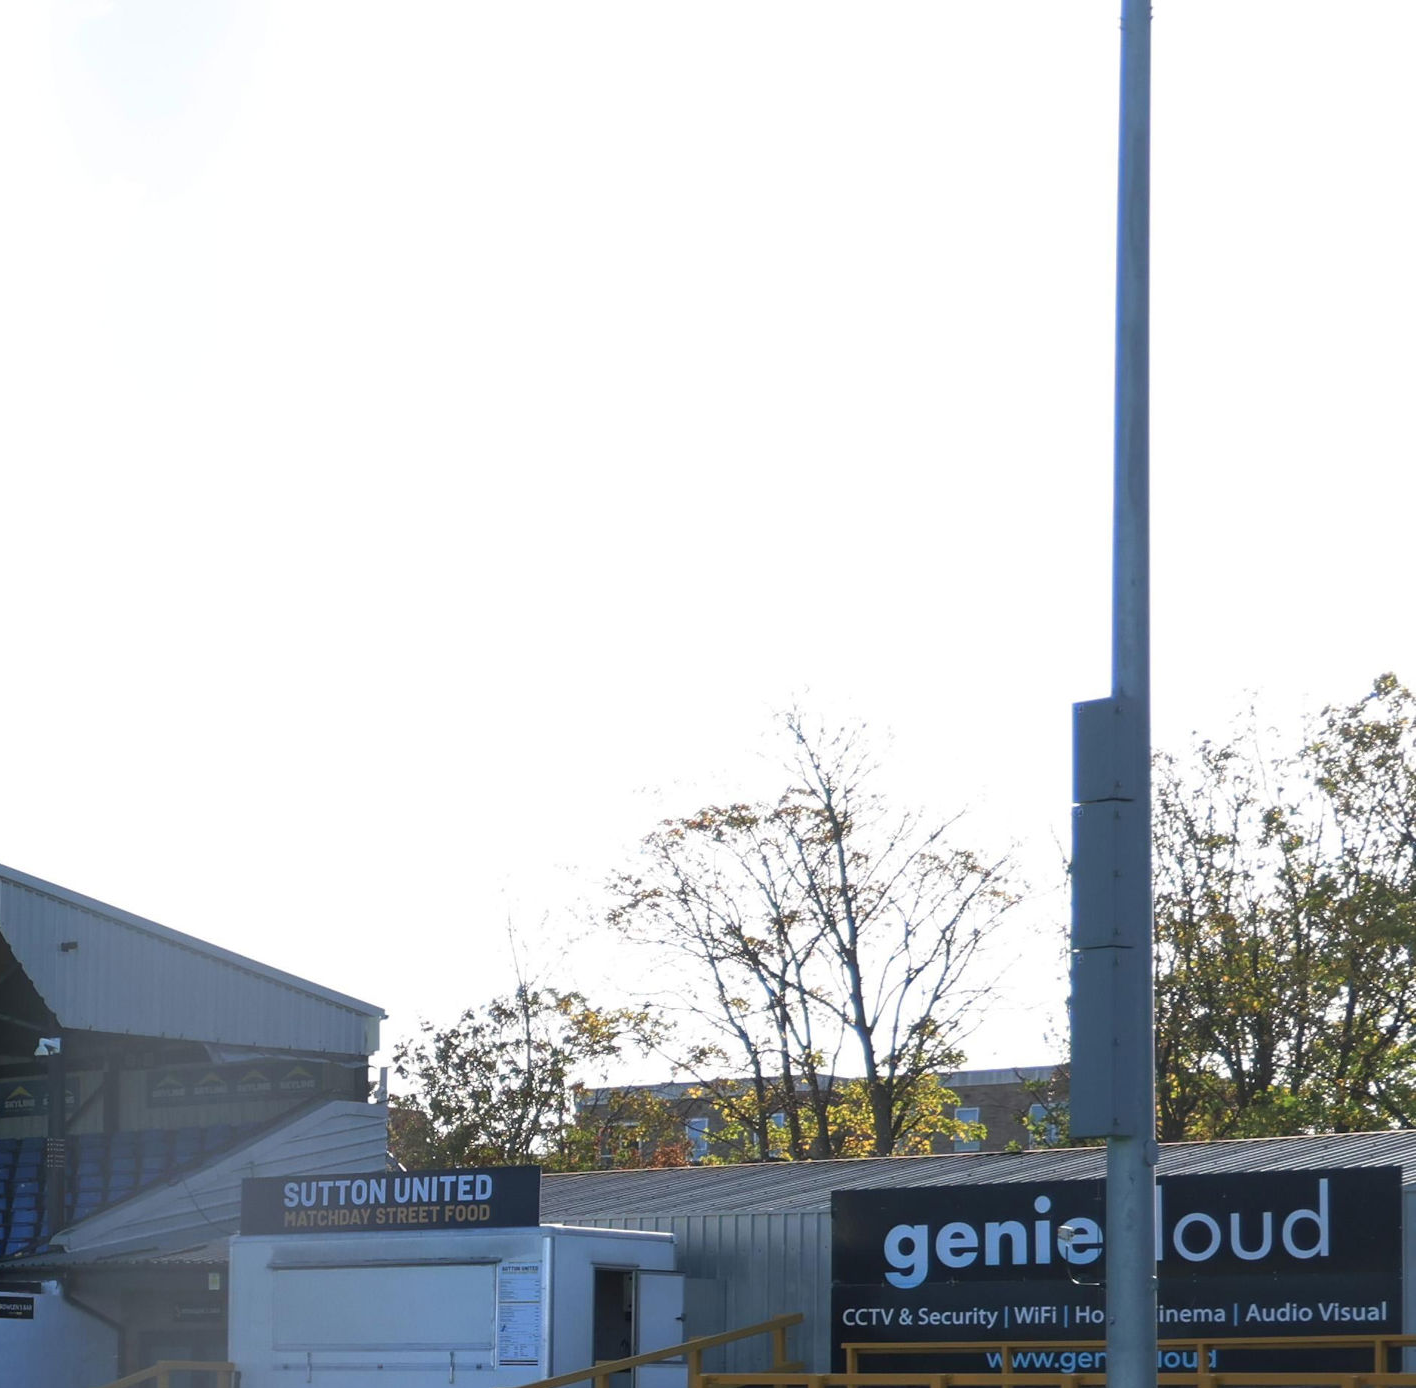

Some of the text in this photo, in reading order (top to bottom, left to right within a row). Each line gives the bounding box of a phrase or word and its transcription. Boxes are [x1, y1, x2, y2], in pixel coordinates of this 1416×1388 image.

[284, 1174, 493, 1208] SUTTON UNITED
[284, 1204, 491, 1228] MATCHDAY STREET FOOD
[842, 1308, 894, 1326] CCTV
[899, 1307, 915, 1325] &
[917, 1306, 998, 1329] Security
[1014, 1305, 1058, 1325] WiFi
[1246, 1303, 1313, 1323] Audio
[1319, 1302, 1387, 1323] Visual
